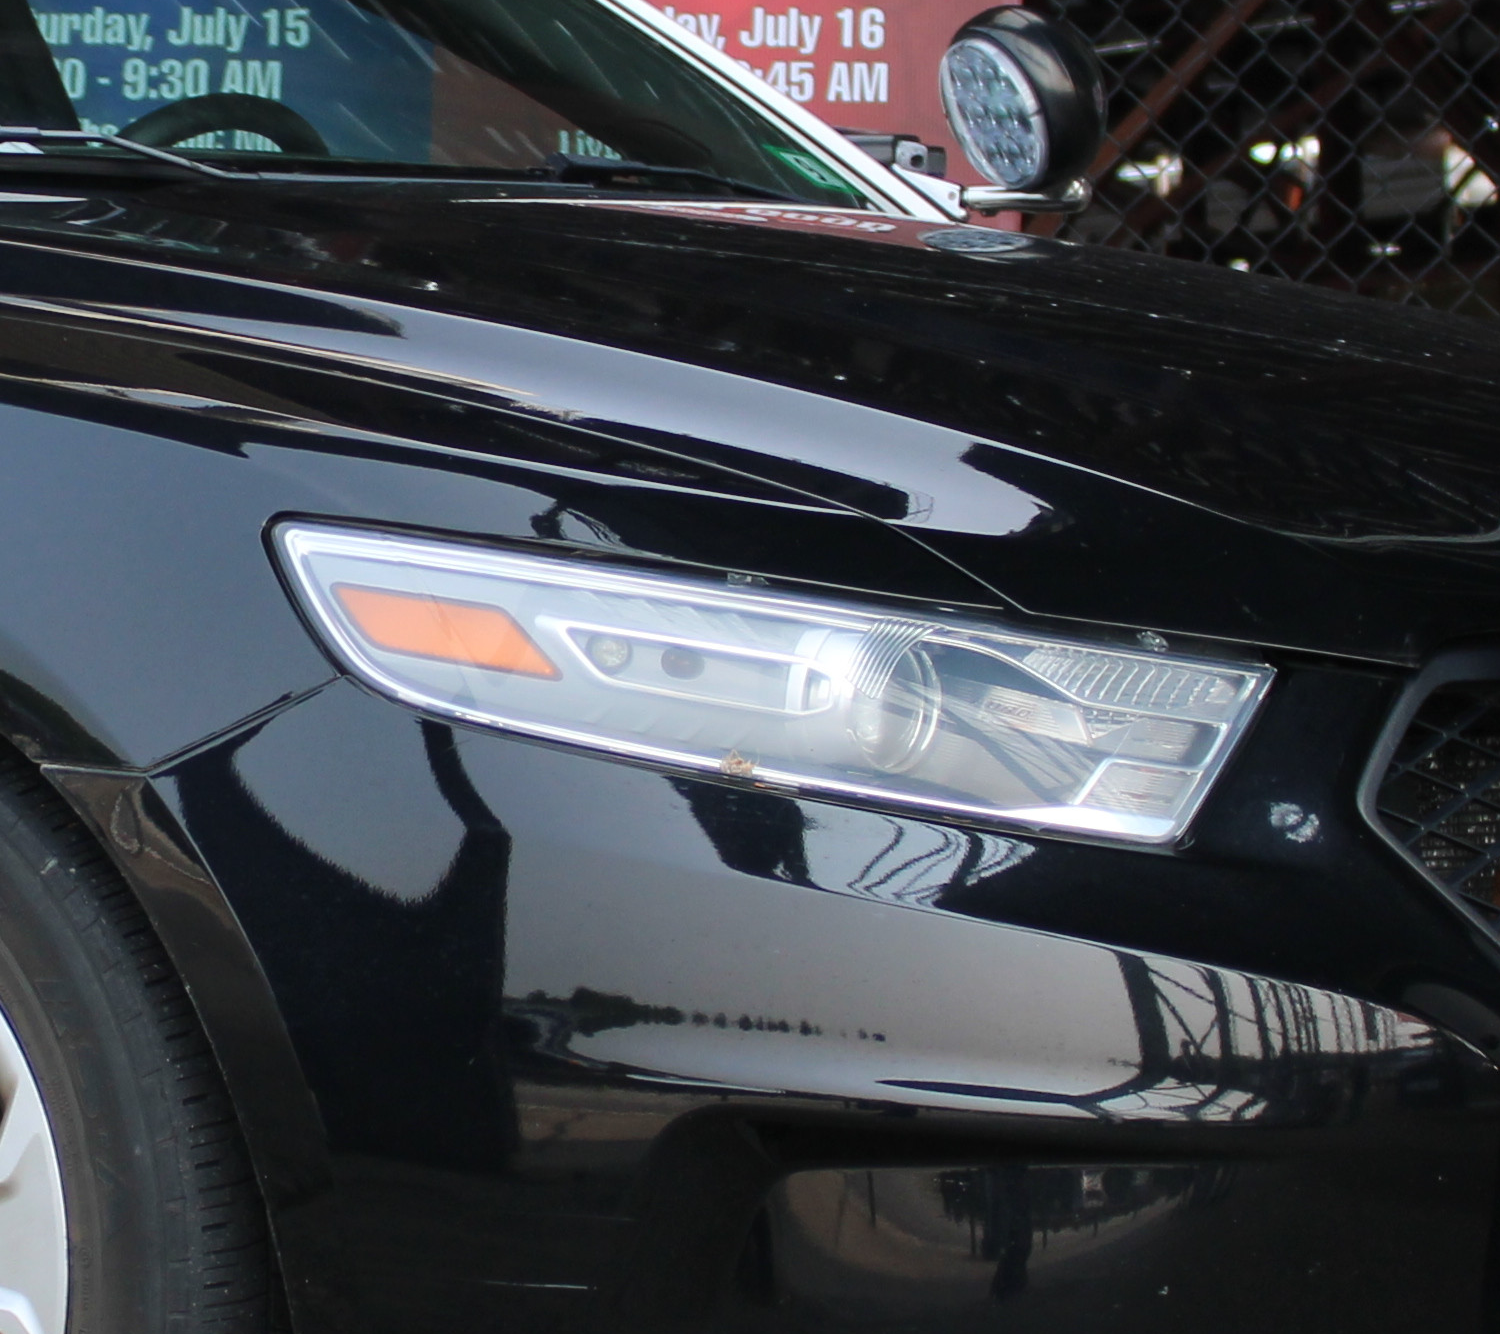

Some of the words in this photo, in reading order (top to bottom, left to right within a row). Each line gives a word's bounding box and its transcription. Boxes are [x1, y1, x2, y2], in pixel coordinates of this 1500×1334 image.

[167, 5, 250, 54] July
[262, 7, 311, 49] 15
[738, 6, 823, 55] July
[835, 7, 887, 50] 16
[122, 57, 212, 102] 9:30
[220, 59, 284, 101] AM
[826, 61, 890, 103] AM
